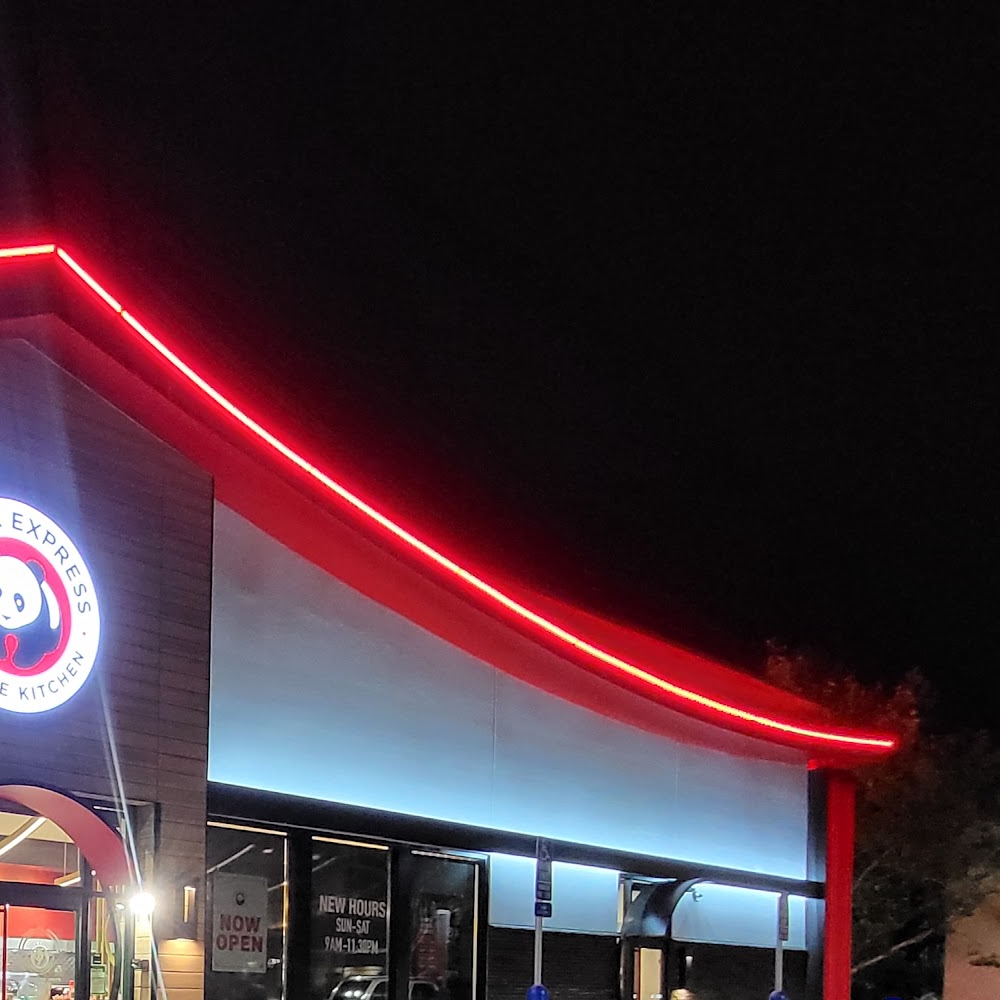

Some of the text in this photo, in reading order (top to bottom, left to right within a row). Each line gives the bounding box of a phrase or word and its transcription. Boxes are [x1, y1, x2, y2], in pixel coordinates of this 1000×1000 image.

[12, 512, 92, 614] EXPRESS
[19, 651, 84, 701] KITCHEN
[319, 895, 387, 918] NEW HOURS
[220, 913, 261, 933] NOW
[216, 933, 263, 953] OPEN
